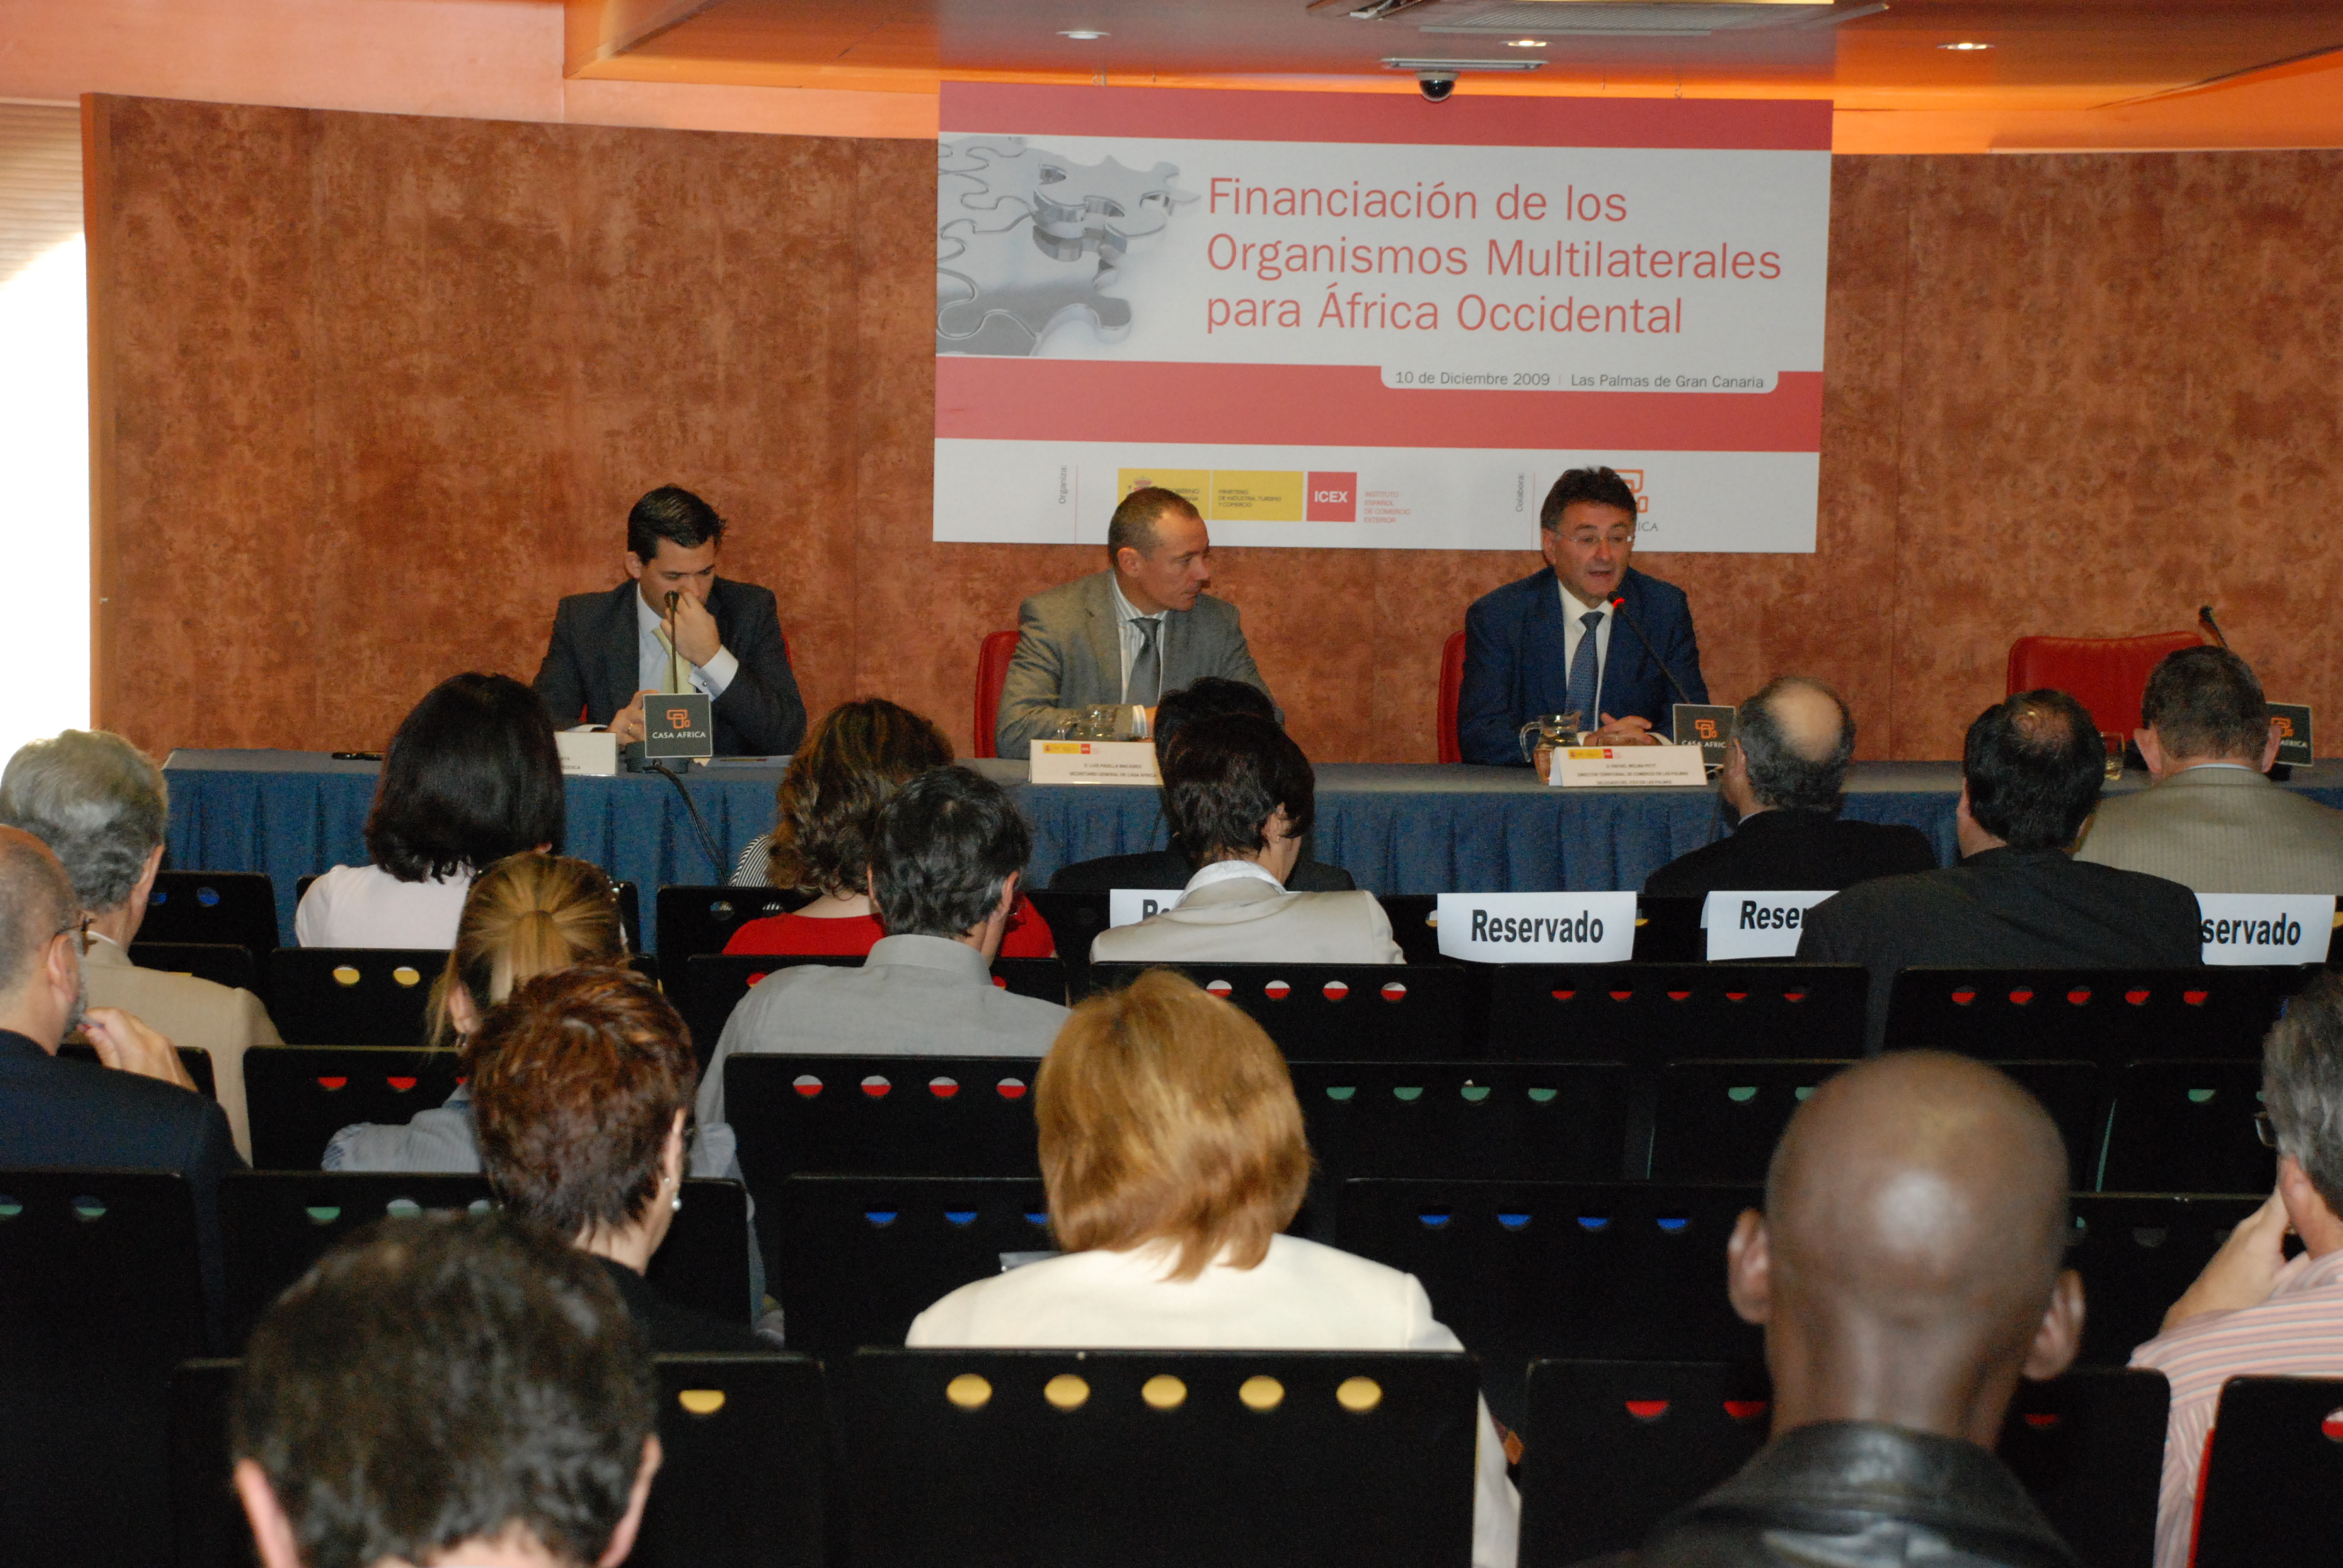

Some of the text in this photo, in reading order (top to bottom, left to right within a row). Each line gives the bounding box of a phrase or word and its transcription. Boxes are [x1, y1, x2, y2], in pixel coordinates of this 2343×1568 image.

[1210, 177, 1628, 223] Financiación de los
[1207, 233, 1781, 281] Organismos Multilaterales
[1207, 283, 1682, 335] para África Occidental
[1396, 371, 1550, 386] 10 de Diciembre 2009
[1571, 374, 1765, 388] Las Palmas de Gran Canaria
[1058, 465, 1069, 504] Organiza:
[1314, 491, 1348, 503] ICEX
[1515, 472, 1525, 513] Colabora:
[1471, 909, 1604, 943] Reservado
[1739, 900, 1807, 929] Reser
[2201, 912, 2301, 946] servado
